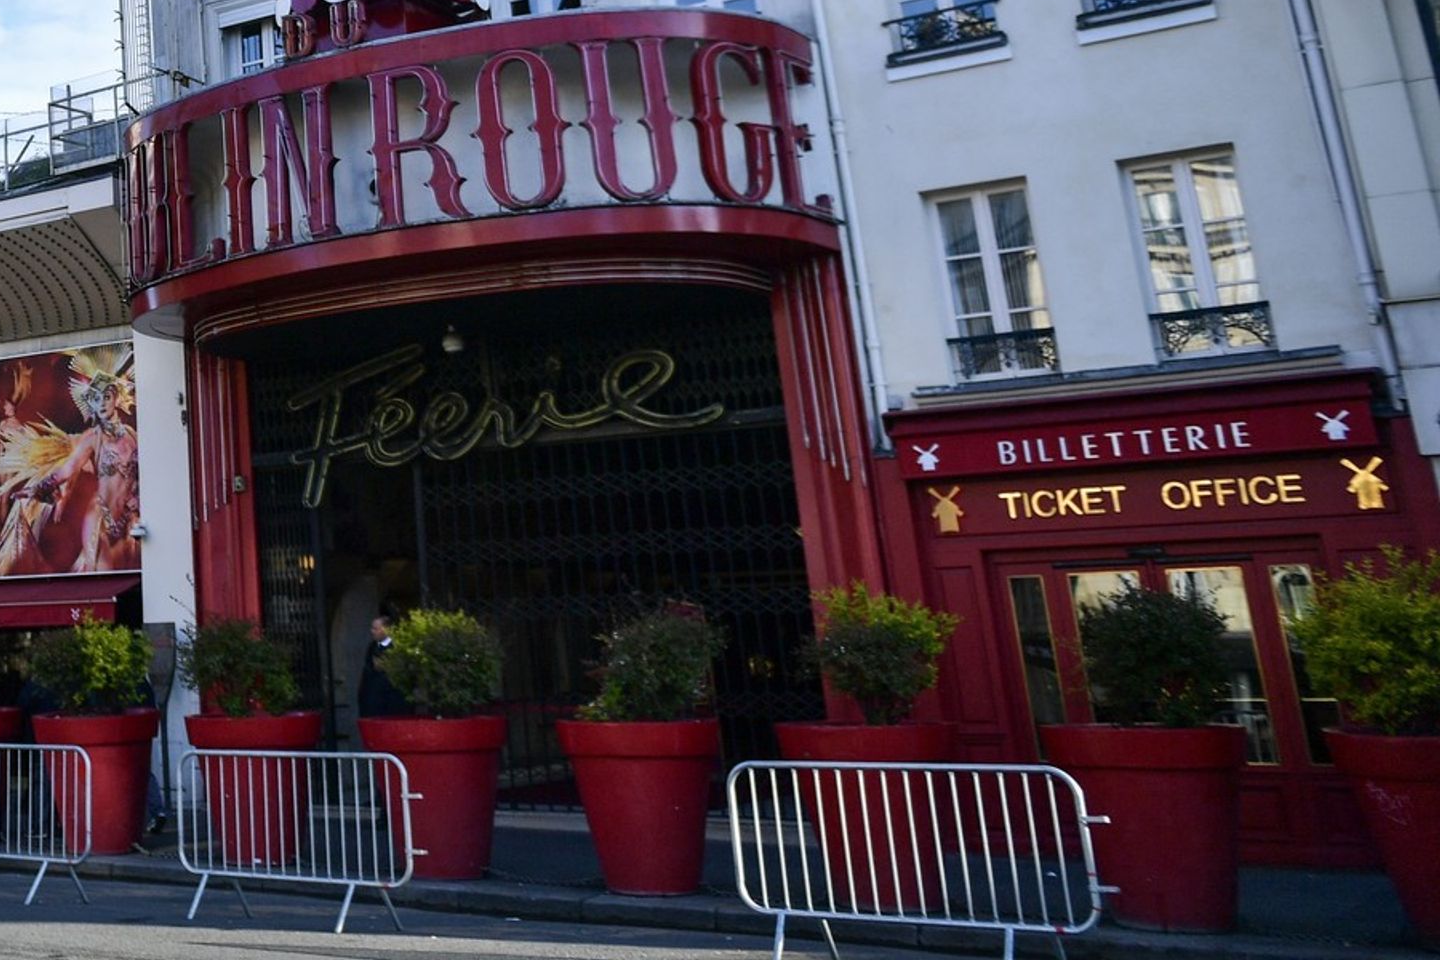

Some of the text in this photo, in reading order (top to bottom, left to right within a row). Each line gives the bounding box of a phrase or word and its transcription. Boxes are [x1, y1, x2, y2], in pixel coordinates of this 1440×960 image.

[365, 38, 836, 228] ROUGE
[998, 421, 1252, 465] BILLETTERIE
[998, 474, 1306, 520] TICKET OFFICE
